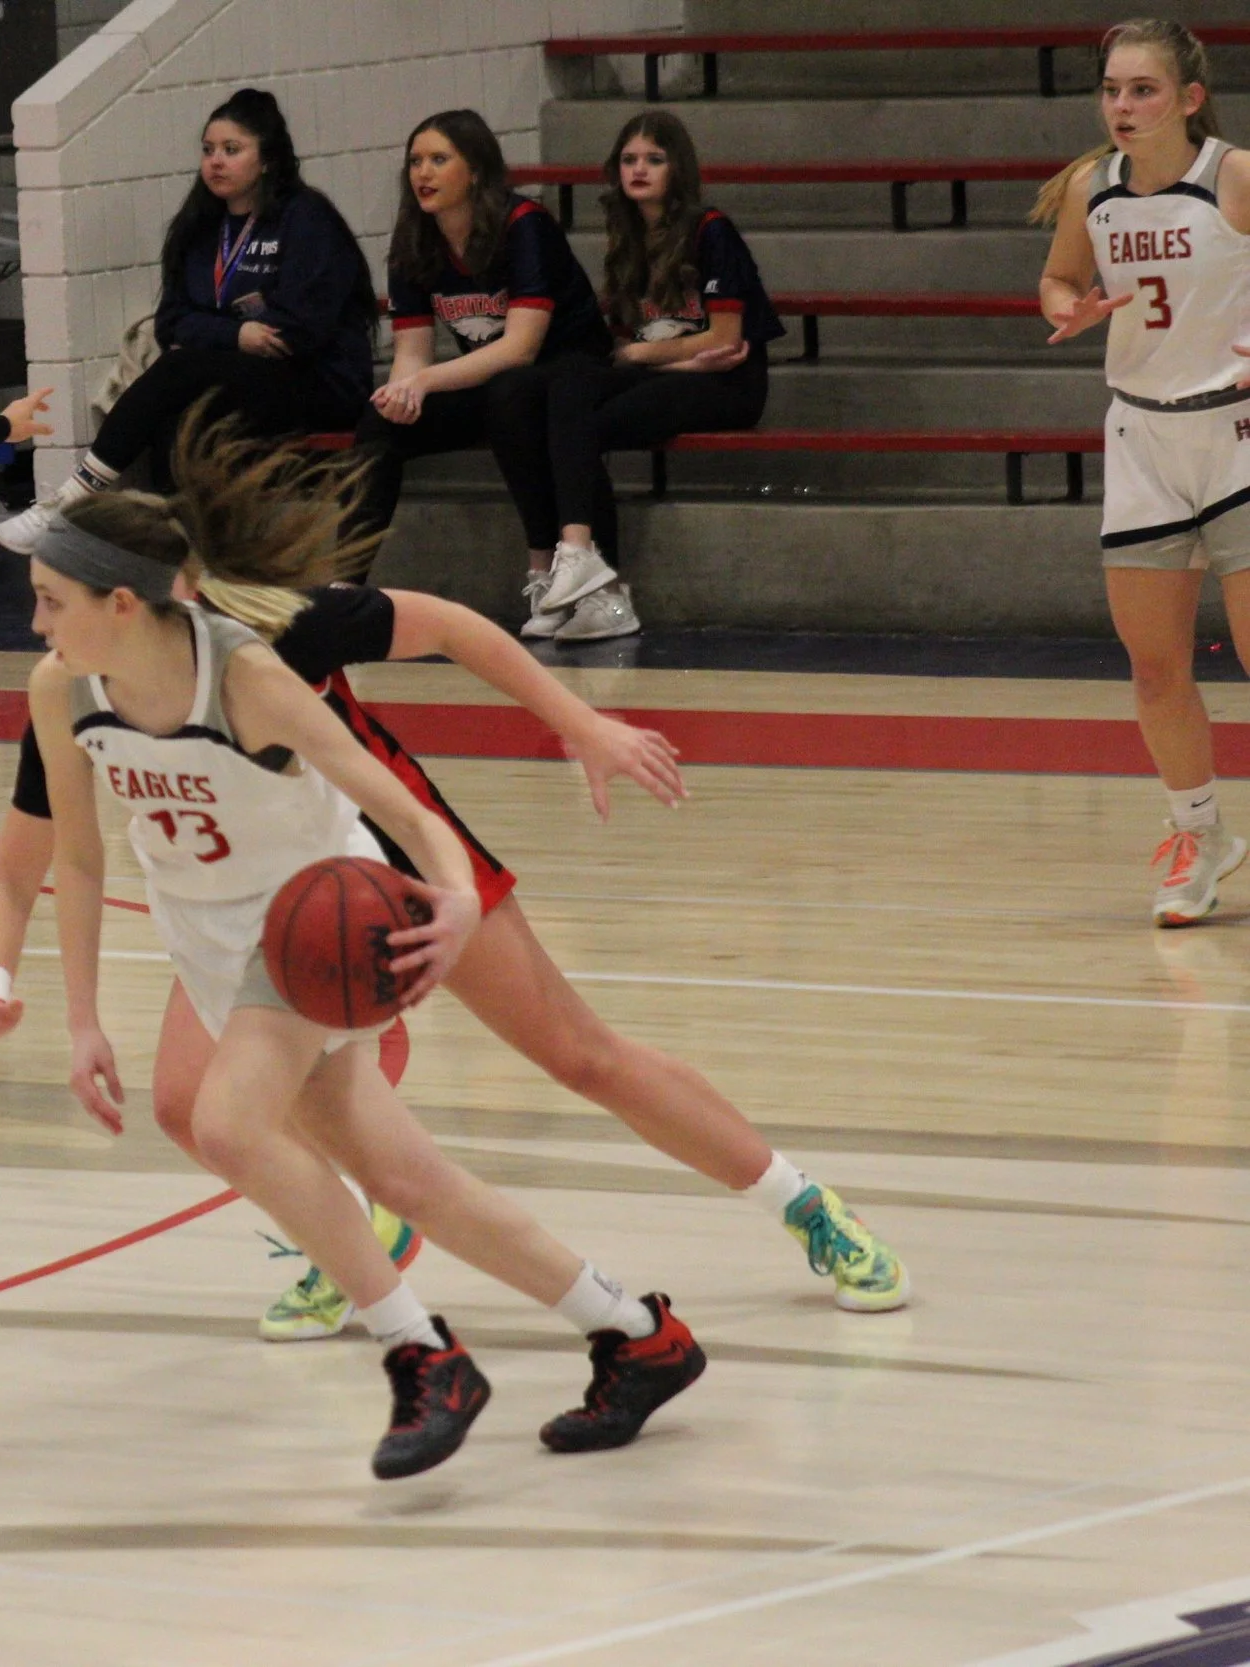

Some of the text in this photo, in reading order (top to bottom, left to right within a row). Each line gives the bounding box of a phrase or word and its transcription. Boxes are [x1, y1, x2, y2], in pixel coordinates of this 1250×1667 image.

[1110, 227, 1192, 265] EAGLES
[432, 291, 510, 322] HERITAG
[1137, 275, 1172, 330] 3
[106, 764, 217, 804] EAGLES
[146, 809, 231, 864] 13
